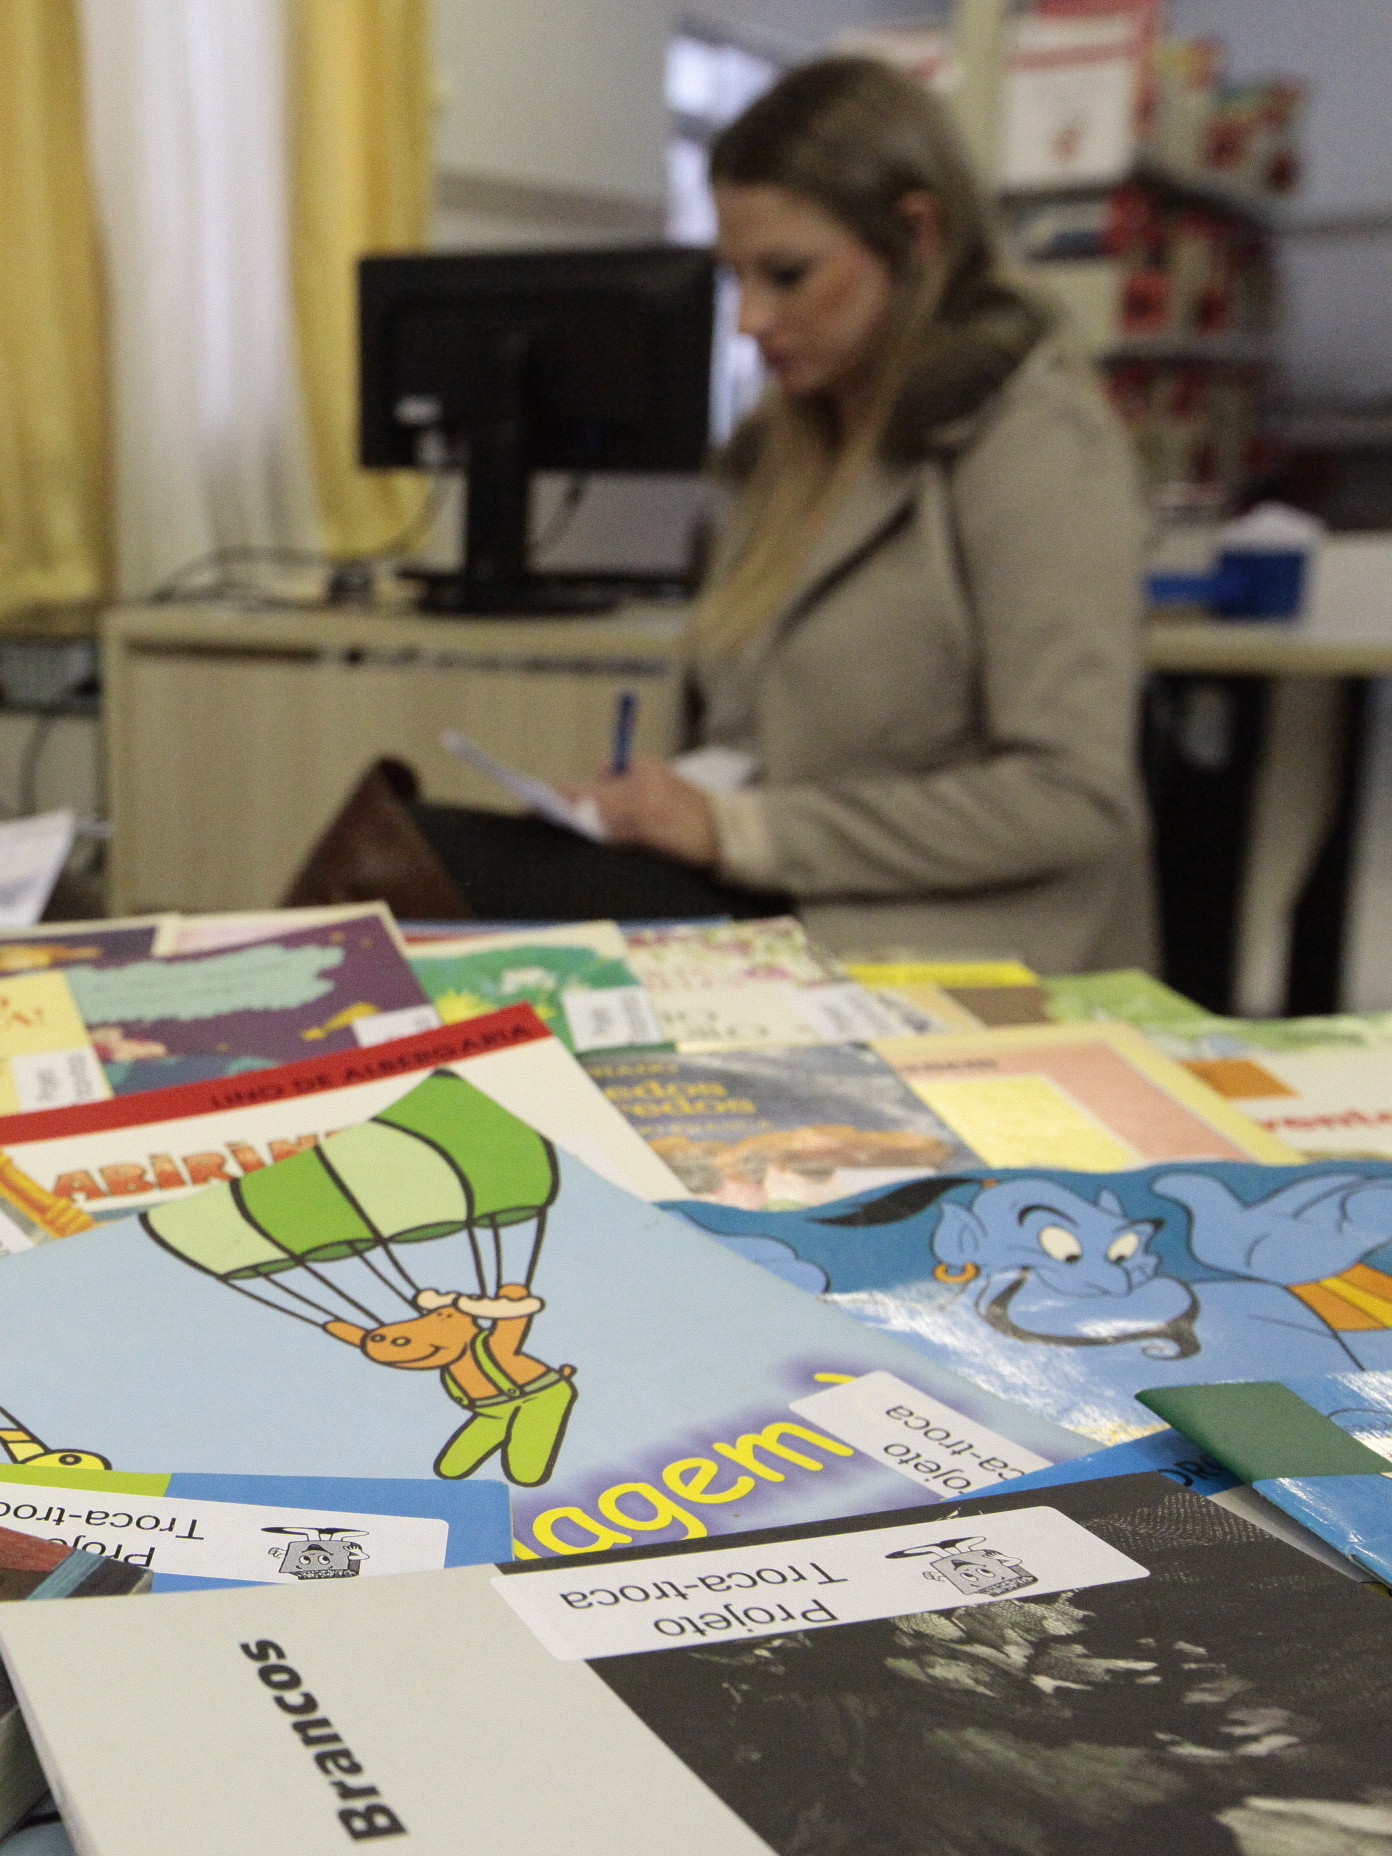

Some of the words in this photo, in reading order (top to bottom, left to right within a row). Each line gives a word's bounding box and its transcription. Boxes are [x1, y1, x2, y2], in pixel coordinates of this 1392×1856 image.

[559, 1561, 849, 1610] Troca-troca
[652, 1598, 840, 1637] Projeto
[239, 1637, 408, 1842] Brancos
